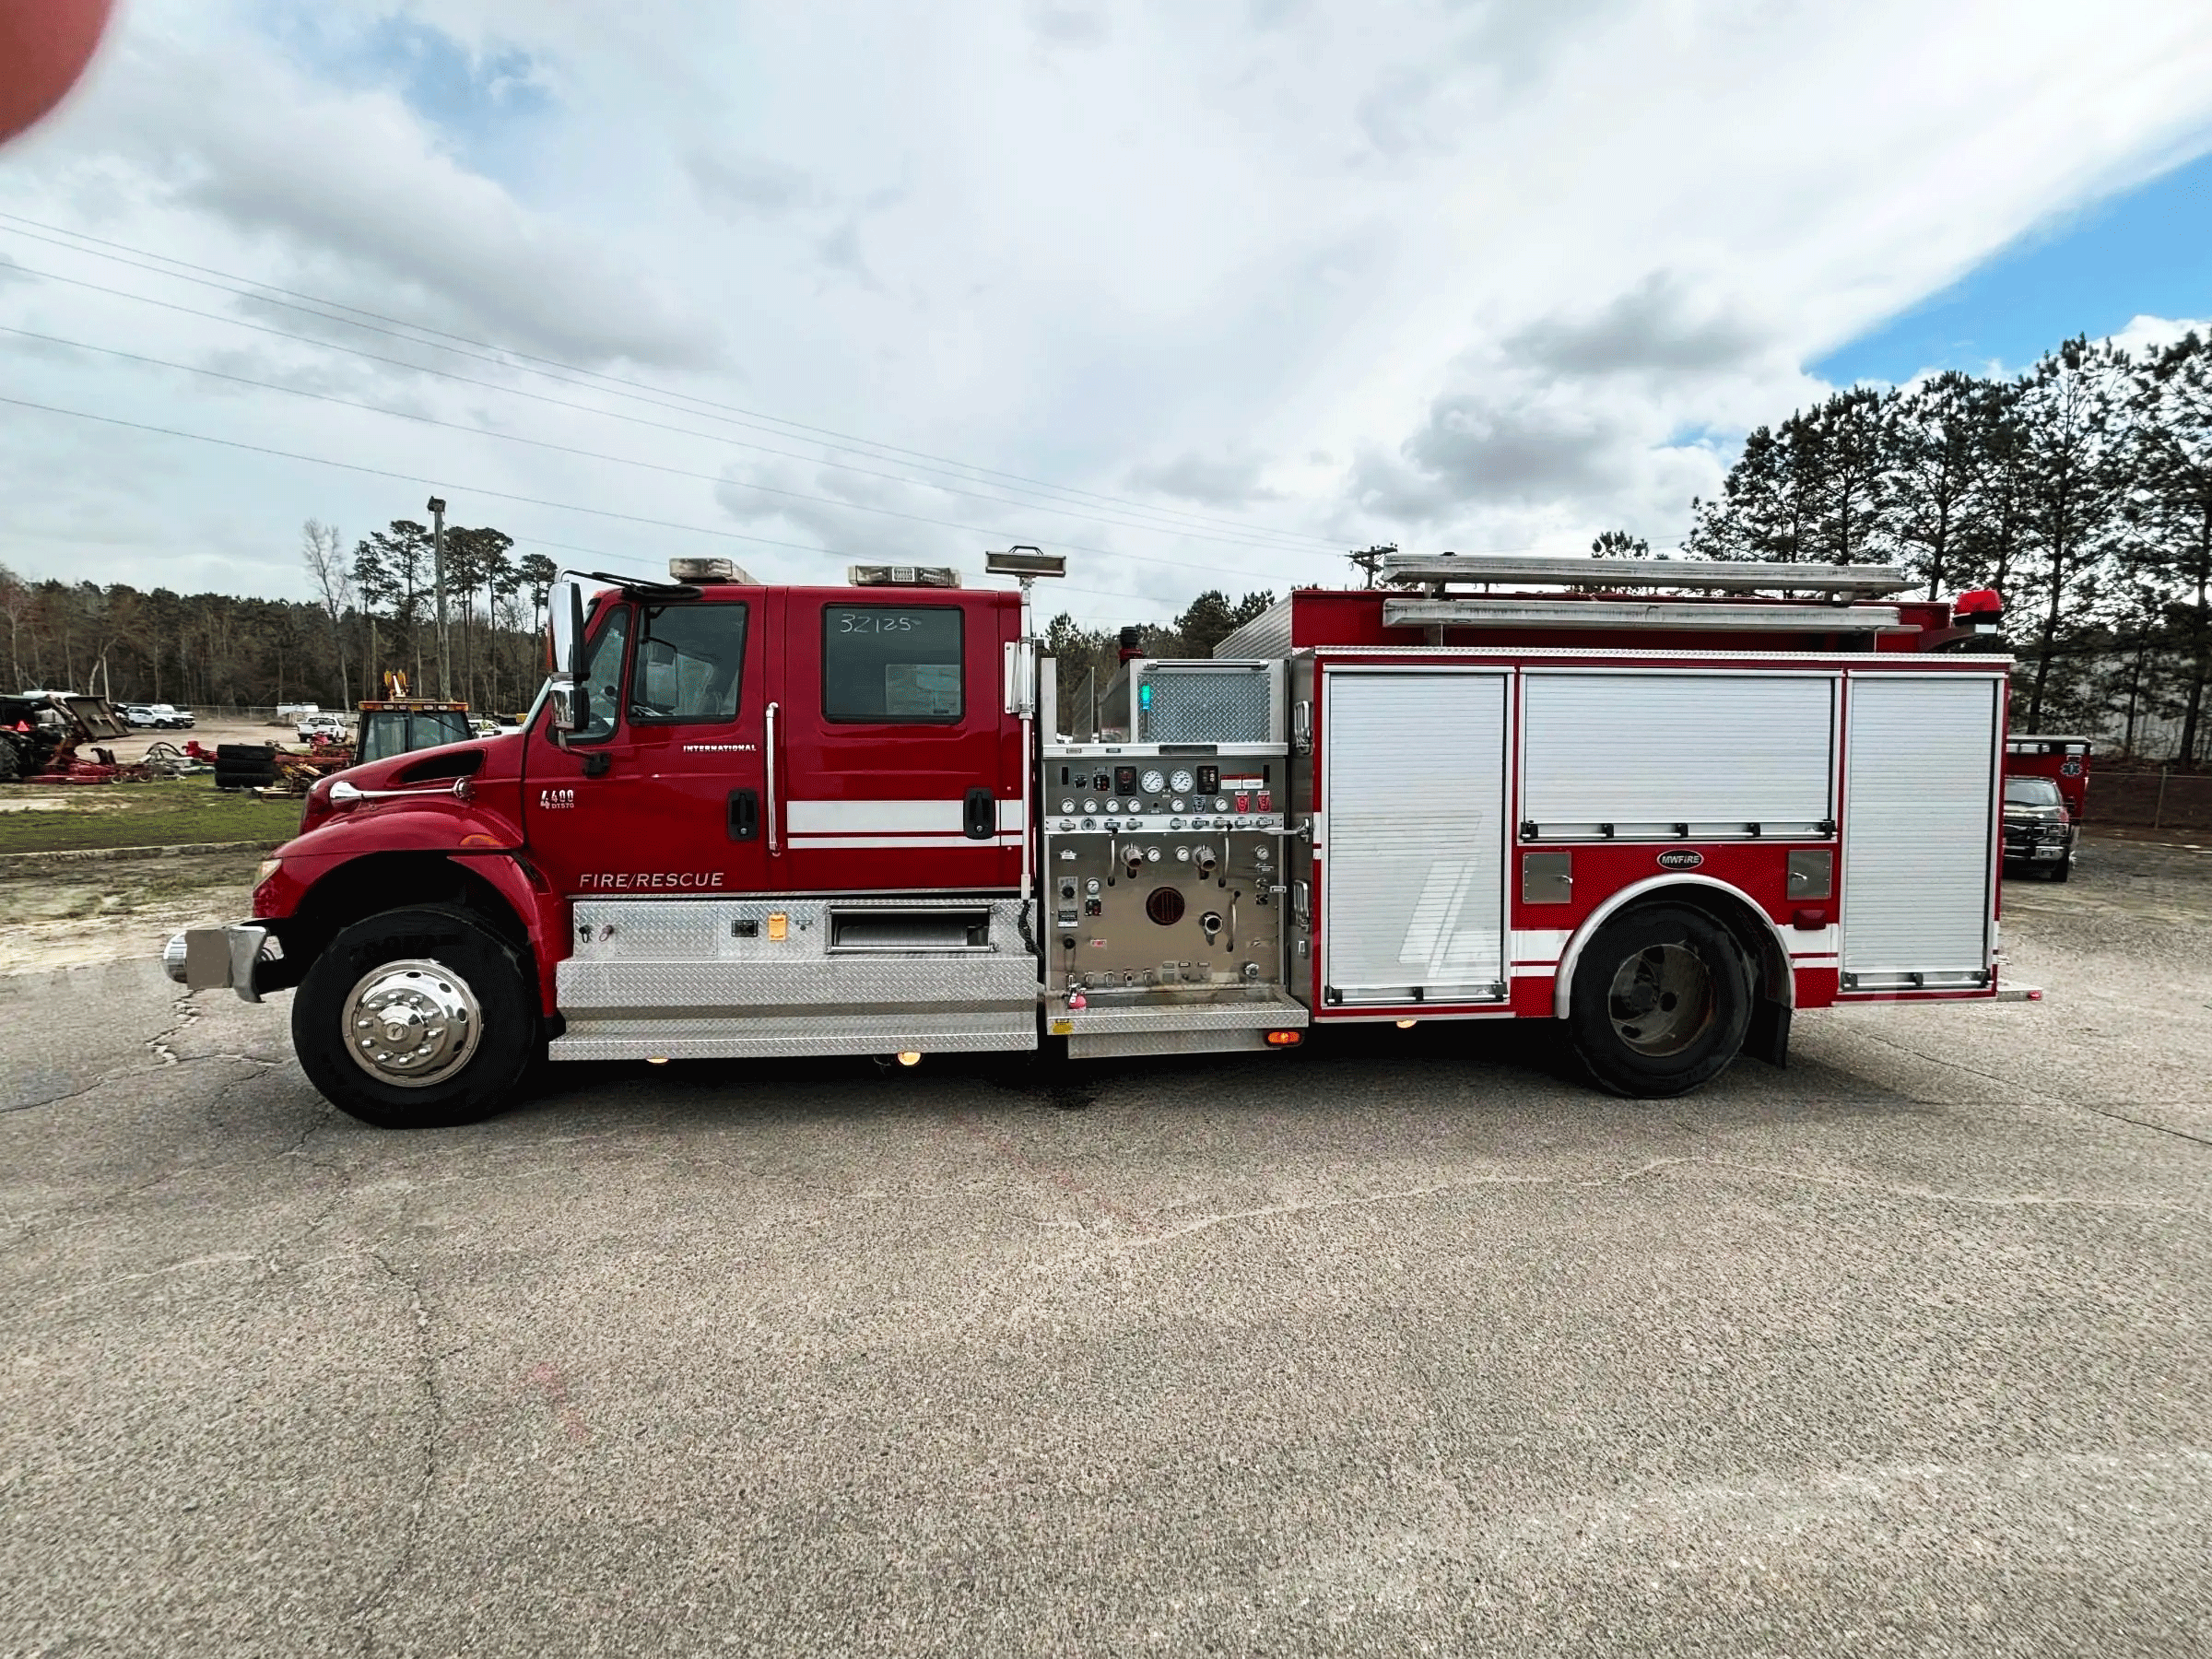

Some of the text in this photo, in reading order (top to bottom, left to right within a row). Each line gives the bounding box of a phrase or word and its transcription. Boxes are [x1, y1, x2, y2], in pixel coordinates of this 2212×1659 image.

[683, 744, 757, 753] INTERNATIONAL
[540, 789, 574, 809] 4400
[580, 872, 724, 889] FIRE/RESCUE
